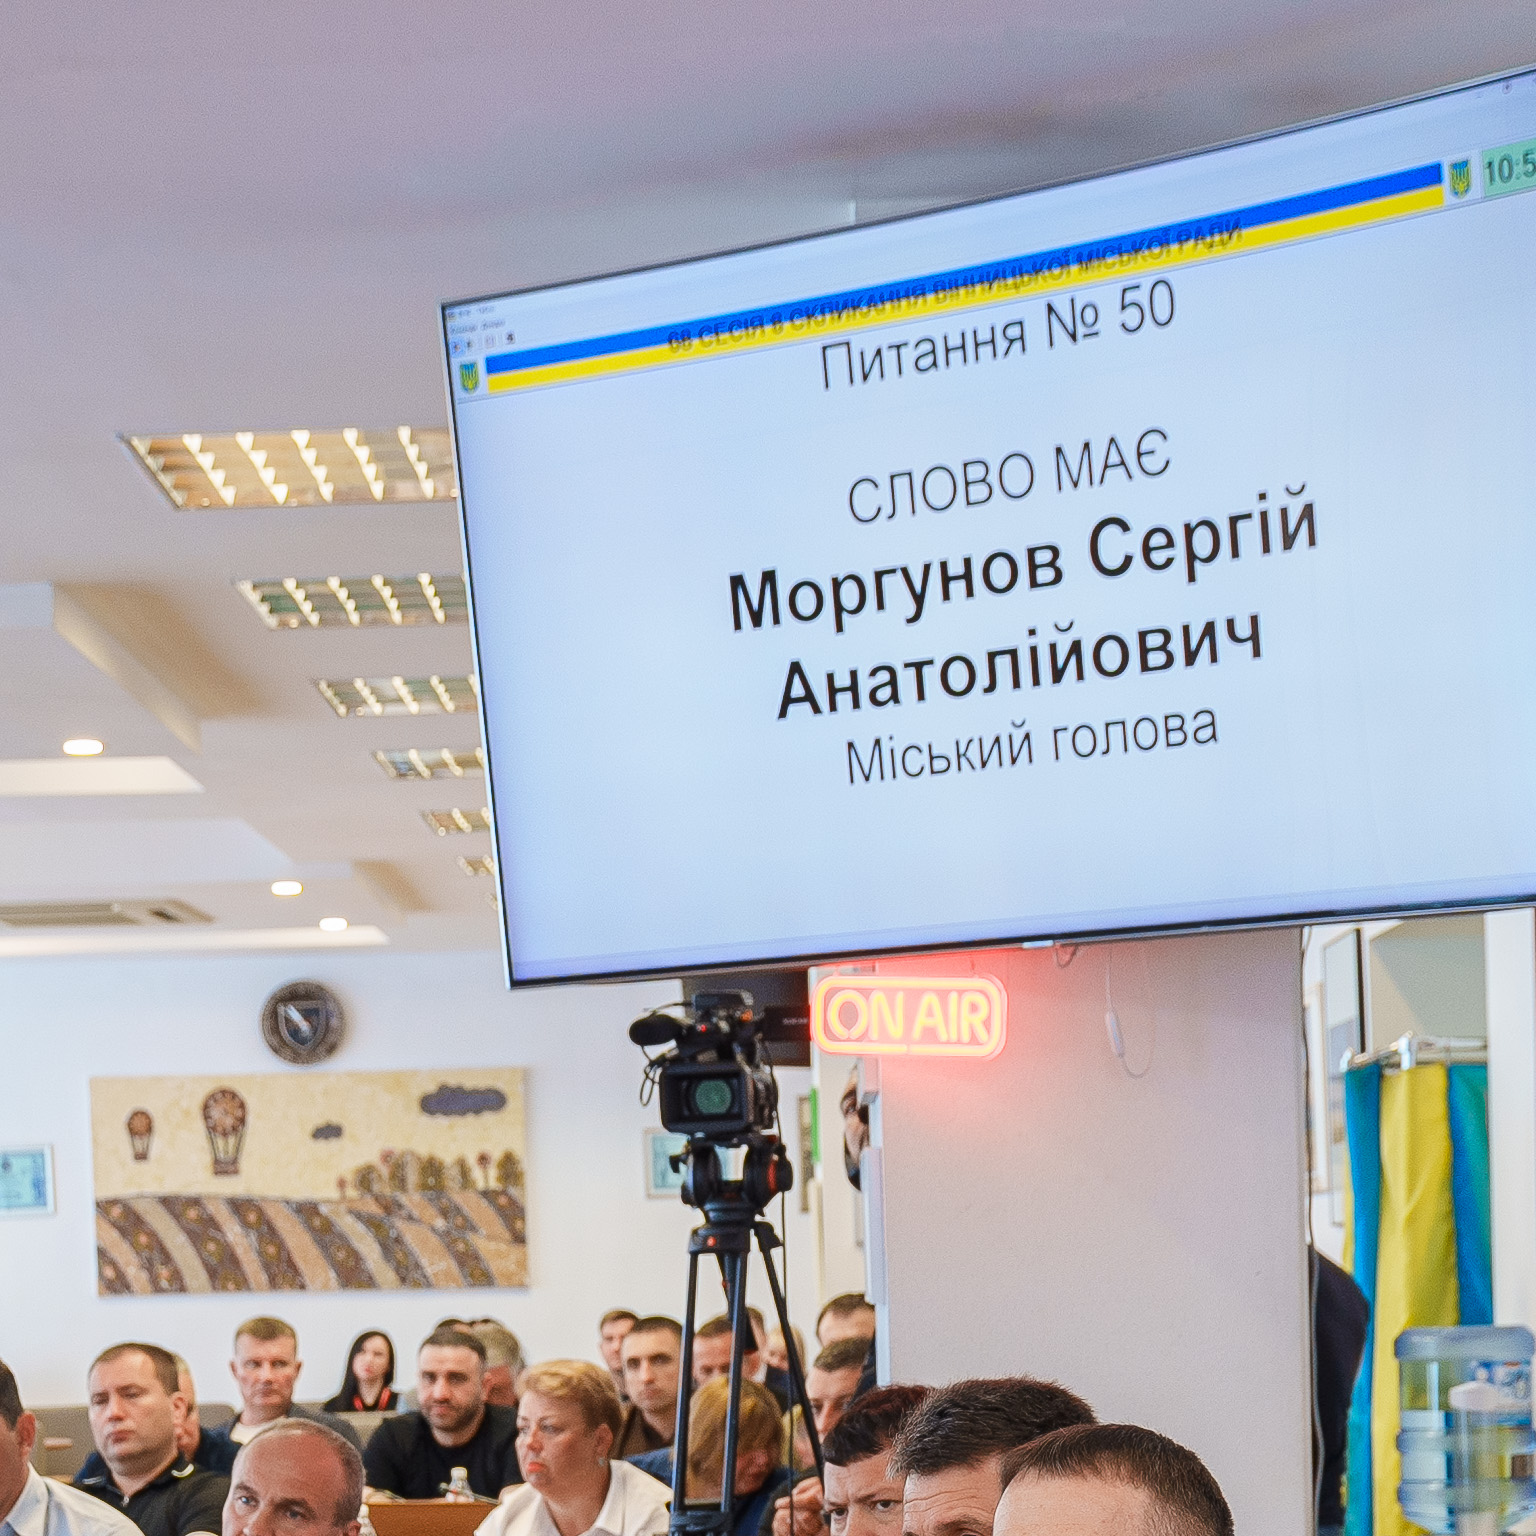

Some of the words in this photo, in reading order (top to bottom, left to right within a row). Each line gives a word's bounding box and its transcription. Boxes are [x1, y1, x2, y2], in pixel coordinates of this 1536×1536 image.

[1172, 217, 1245, 256] РАДИ
[820, 319, 1026, 391] Питання
[1045, 296, 1100, 350] №
[1119, 278, 1176, 334] 50
[848, 451, 1036, 524] СЛОВО
[1055, 427, 1171, 492] МАЄ
[728, 543, 1065, 634] Моргунов
[1088, 482, 1318, 584] Сергій
[776, 613, 1262, 721] Анатолійович
[846, 718, 1034, 786] Міський
[1052, 708, 1219, 762] голова
[828, 990, 904, 1039] ON
[913, 991, 989, 1042] AIR
